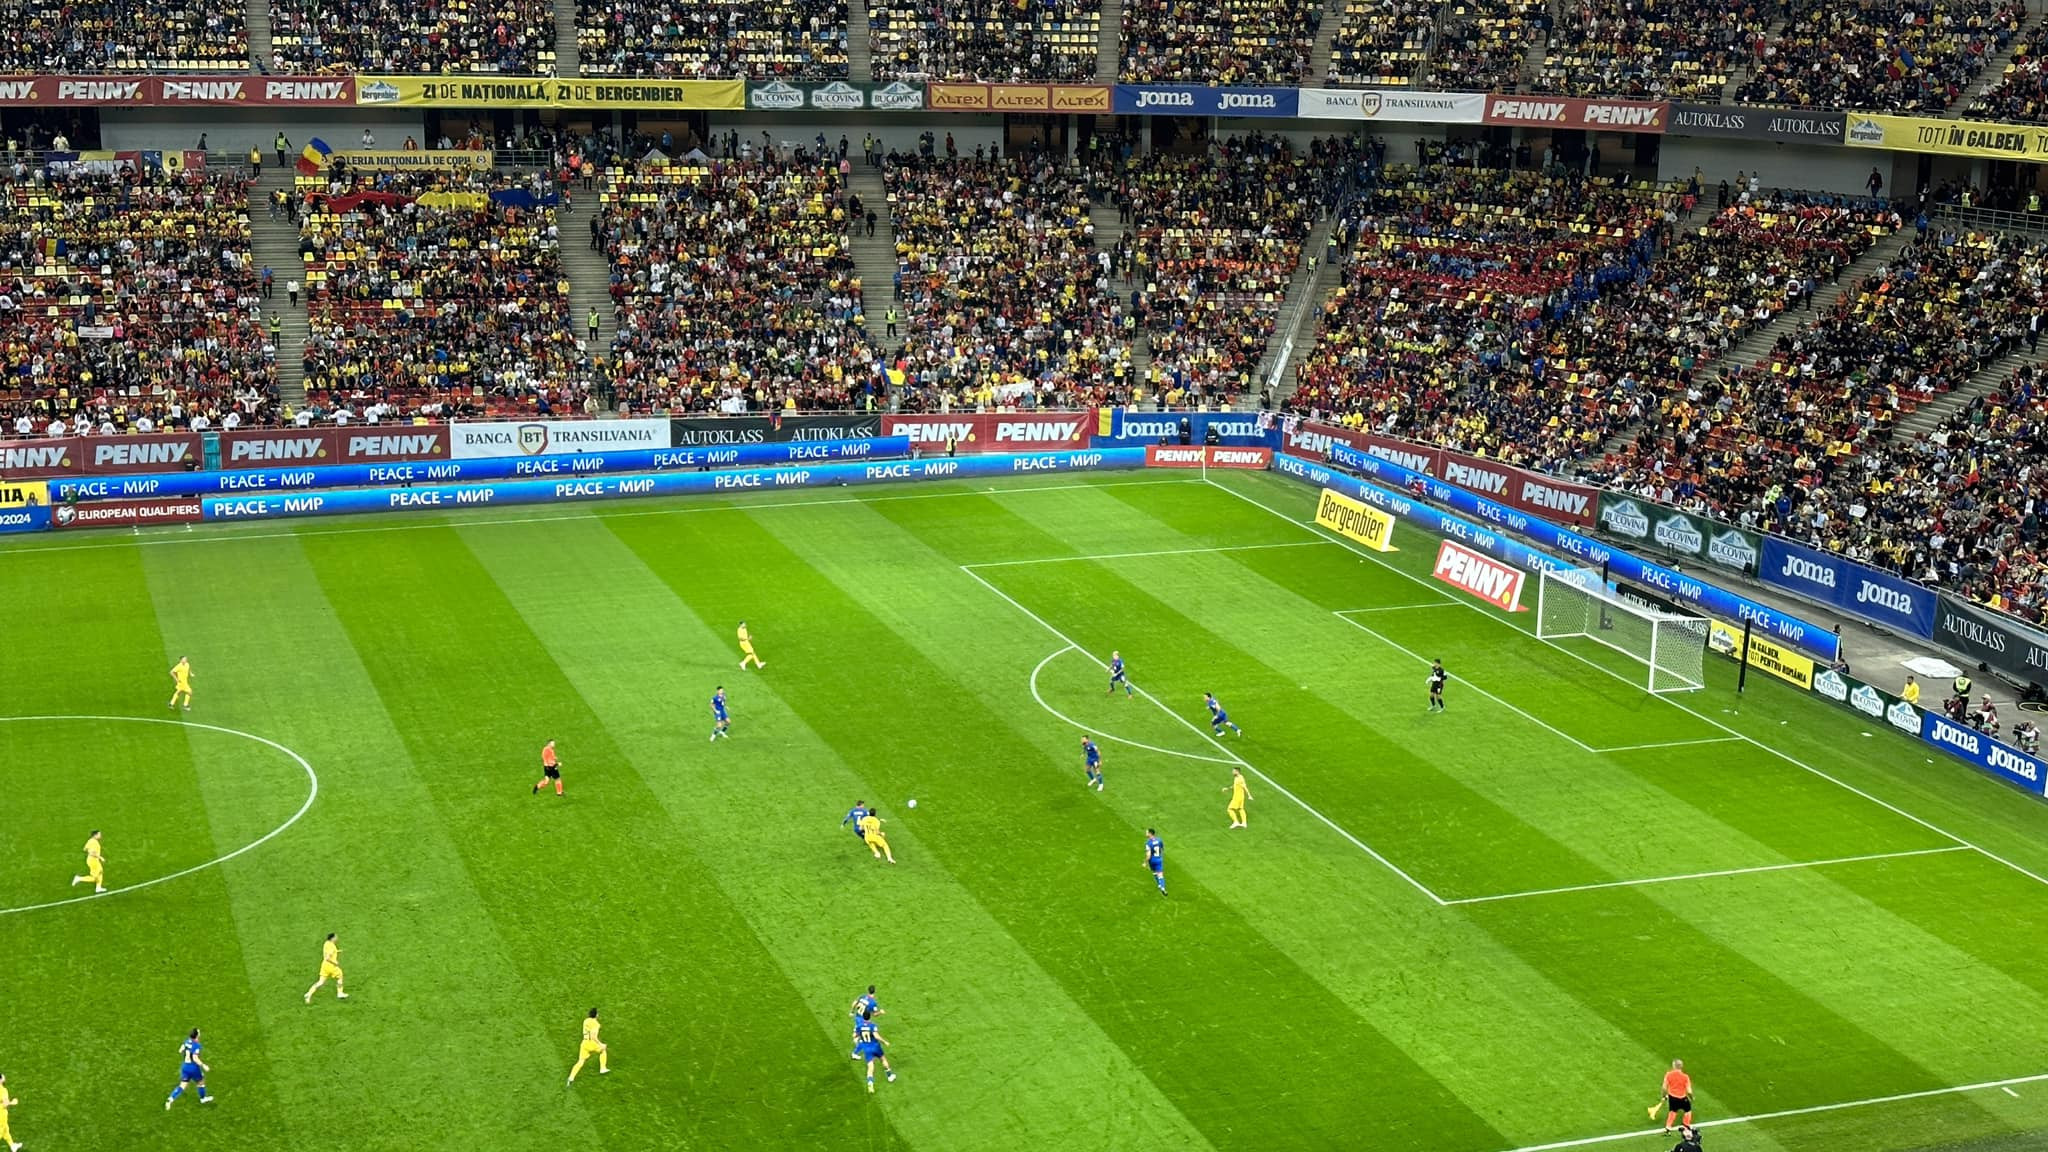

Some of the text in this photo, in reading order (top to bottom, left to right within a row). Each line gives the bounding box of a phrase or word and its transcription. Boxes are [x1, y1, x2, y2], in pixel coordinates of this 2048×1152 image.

[422, 84, 436, 99] ZI
[440, 84, 457, 99] DE
[557, 84, 571, 100] ZI
[575, 84, 592, 100] DE
[596, 86, 683, 102] BERGENBIER
[754, 94, 800, 103] BUCOVINA
[814, 94, 861, 103] BUCOVINA
[874, 95, 920, 104] BUCOVINA
[1325, 97, 1455, 110] BANCA BT TRANSILVANIA
[1674, 111, 1745, 129] AUTOKLASS
[1768, 118, 1840, 135] AUTOKLASS
[1948, 125, 1965, 146] ÎN
[433, 156, 445, 165] DE
[465, 429, 652, 445] BANCA BT TRANSILVANIA
[680, 429, 764, 446] AUTOKLASS
[791, 427, 873, 442] AUTOKLASS
[654, 452, 694, 466] PEACE
[707, 450, 738, 464] МИР
[789, 446, 828, 459] PEACE
[841, 443, 870, 456] МИР
[1335, 448, 1357, 467] PEACE
[517, 460, 558, 474] PEACE
[572, 458, 604, 471] МИР
[866, 465, 910, 479] PEACE
[925, 463, 958, 476] МИР
[1013, 456, 1057, 471] PEACE
[1070, 454, 1102, 467] МИР
[1279, 458, 1304, 476] PEACE
[1310, 468, 1330, 484] МИР
[220, 475, 266, 489] PEACE
[281, 472, 315, 486] МИР
[370, 467, 414, 481] PEACE
[428, 465, 461, 478] МИР
[715, 474, 761, 489] PEACE
[776, 471, 810, 485] МИР
[123, 480, 159, 494] МИР
[556, 482, 604, 497] PEACE
[619, 480, 655, 493] МИР
[390, 491, 440, 506] PEACE
[457, 489, 494, 503] МИР
[1359, 485, 1385, 506] PEACE
[1391, 498, 1411, 515] МИР
[78, 505, 200, 520] EUROPEAN QUALIFIERS
[214, 502, 268, 517] PEACE
[284, 497, 324, 512] МИР
[1477, 501, 1501, 523] PEACE
[1507, 513, 1527, 530] МИР
[1321, 494, 1385, 542] Bergenbier
[1605, 512, 1645, 531] BUCOVINA
[1441, 517, 1466, 540] PEACE
[1474, 531, 1495, 549] МИР
[1657, 527, 1698, 546] BUCOVINA
[1557, 533, 1582, 554] PEACE
[1712, 542, 1753, 561] BUCOVINA
[1642, 566, 1670, 589] PEACE
[1678, 580, 1702, 600] МИР
[1738, 604, 1770, 629] PEACE
[1779, 620, 1804, 641] МИР
[1942, 613, 2005, 652] AUTOKLASS
